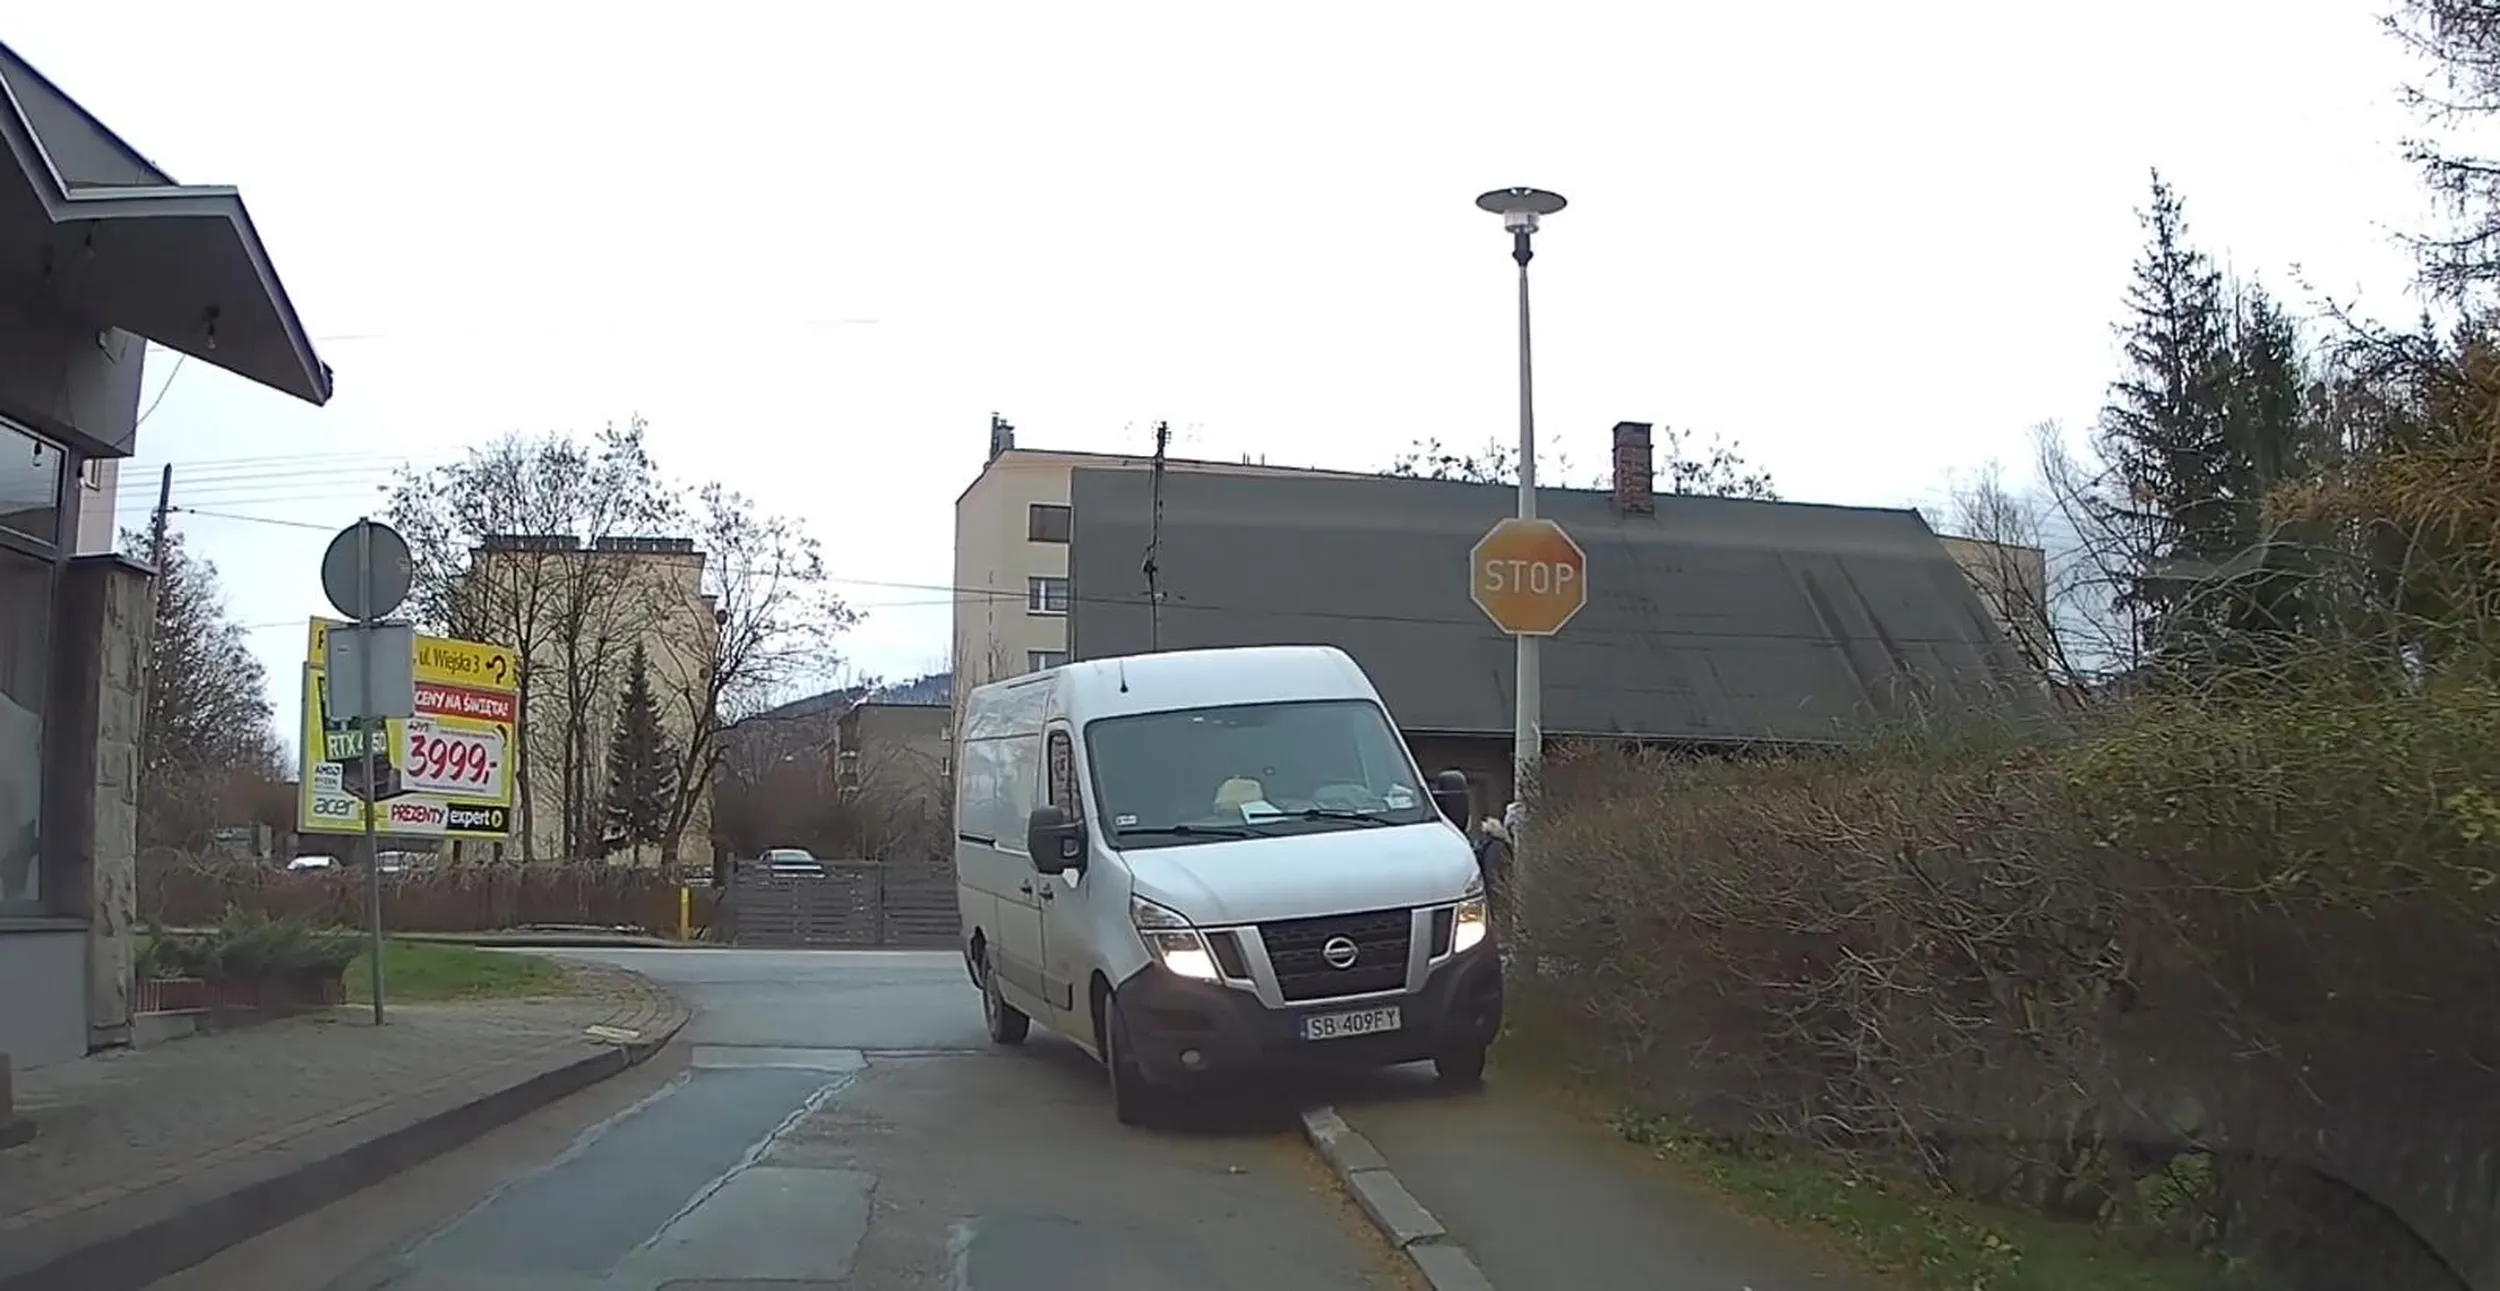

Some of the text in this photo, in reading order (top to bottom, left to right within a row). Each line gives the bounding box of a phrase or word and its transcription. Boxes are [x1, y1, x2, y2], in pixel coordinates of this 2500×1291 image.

[1485, 559, 1574, 595] STOP
[433, 647, 472, 675] Wiejska
[473, 654, 481, 674] 3
[414, 690, 445, 709] CENY
[446, 693, 462, 712] NA
[327, 733, 357, 757] RTX
[313, 798, 355, 816] acer
[391, 803, 445, 824] PREZENTY
[450, 809, 491, 829] expert
[1311, 1009, 1396, 1038] SB 409FY
